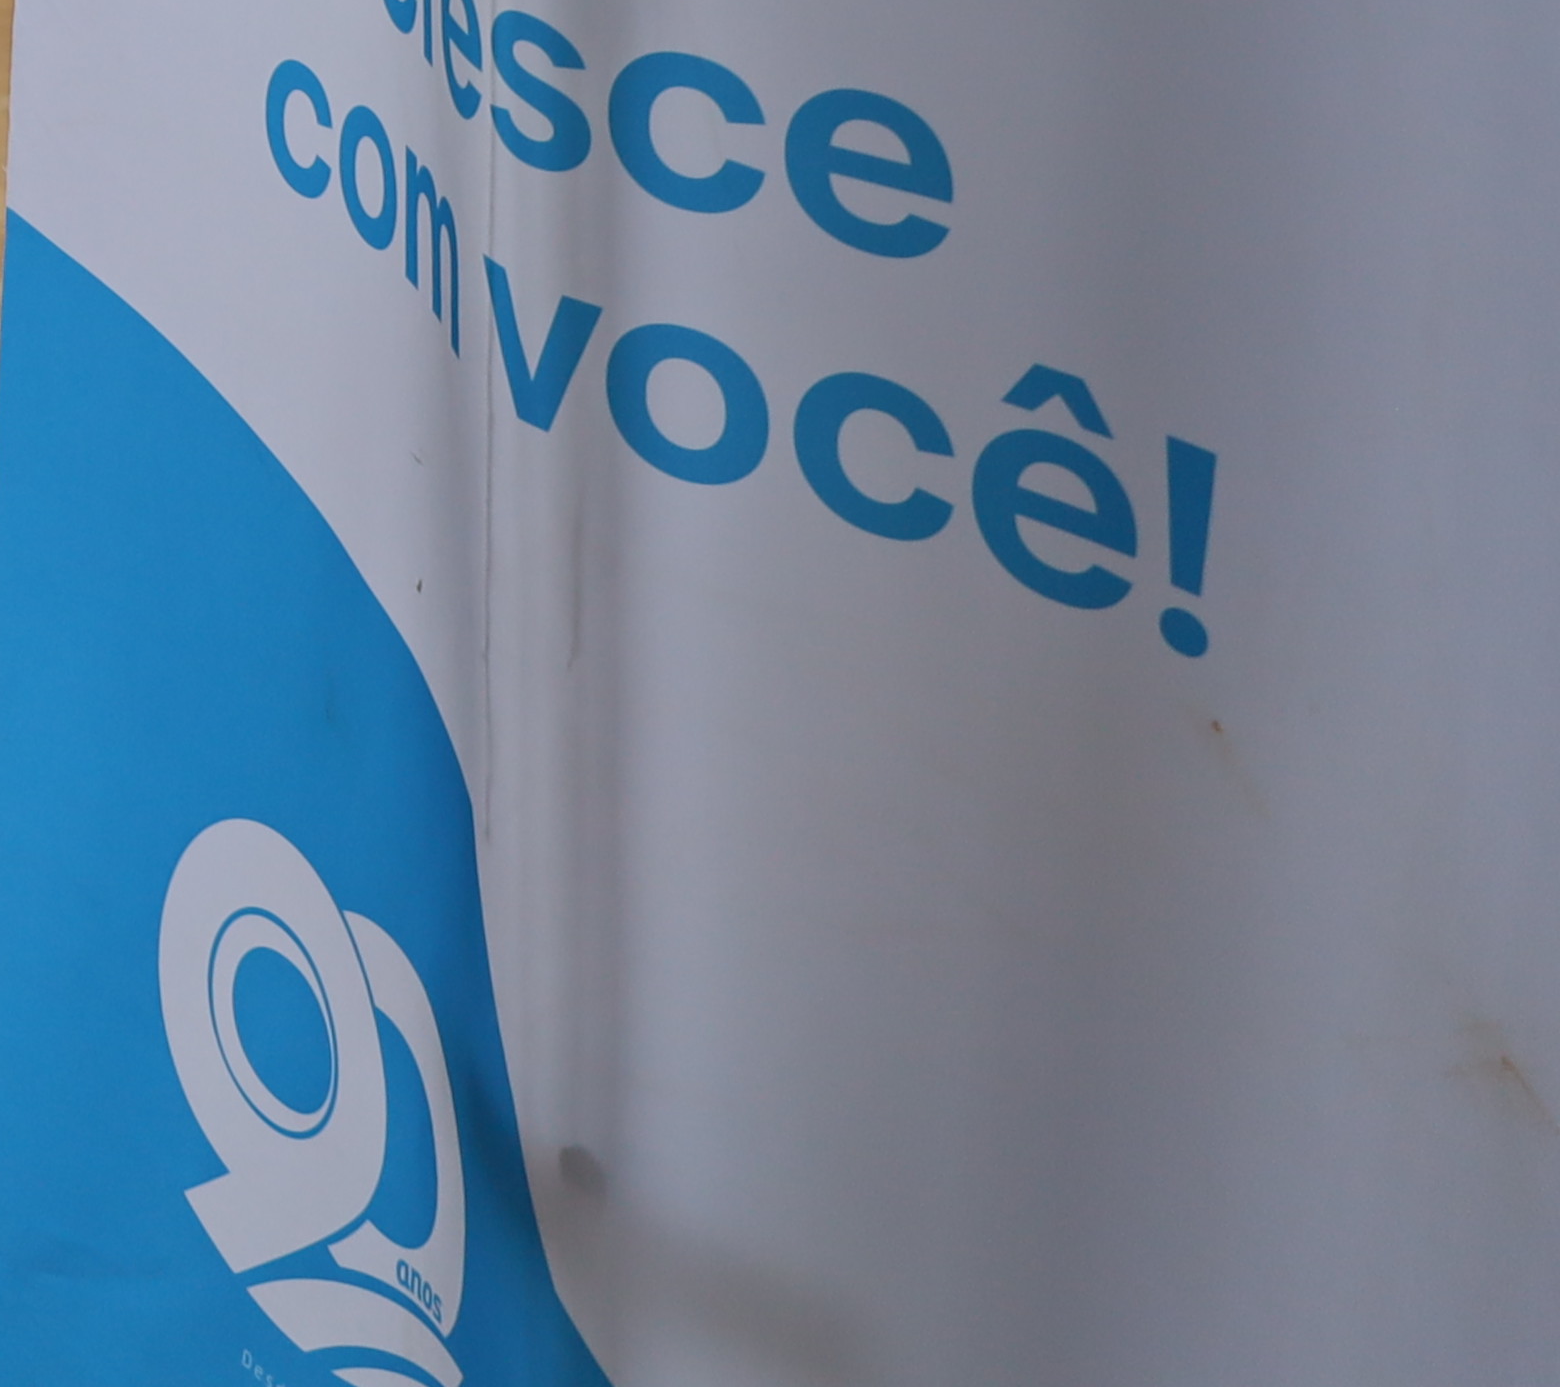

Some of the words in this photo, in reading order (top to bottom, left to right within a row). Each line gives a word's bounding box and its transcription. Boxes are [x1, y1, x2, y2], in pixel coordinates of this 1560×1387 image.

[263, 57, 462, 357] com
[482, 362, 1220, 659] você!
[396, 1258, 442, 1325] anos
